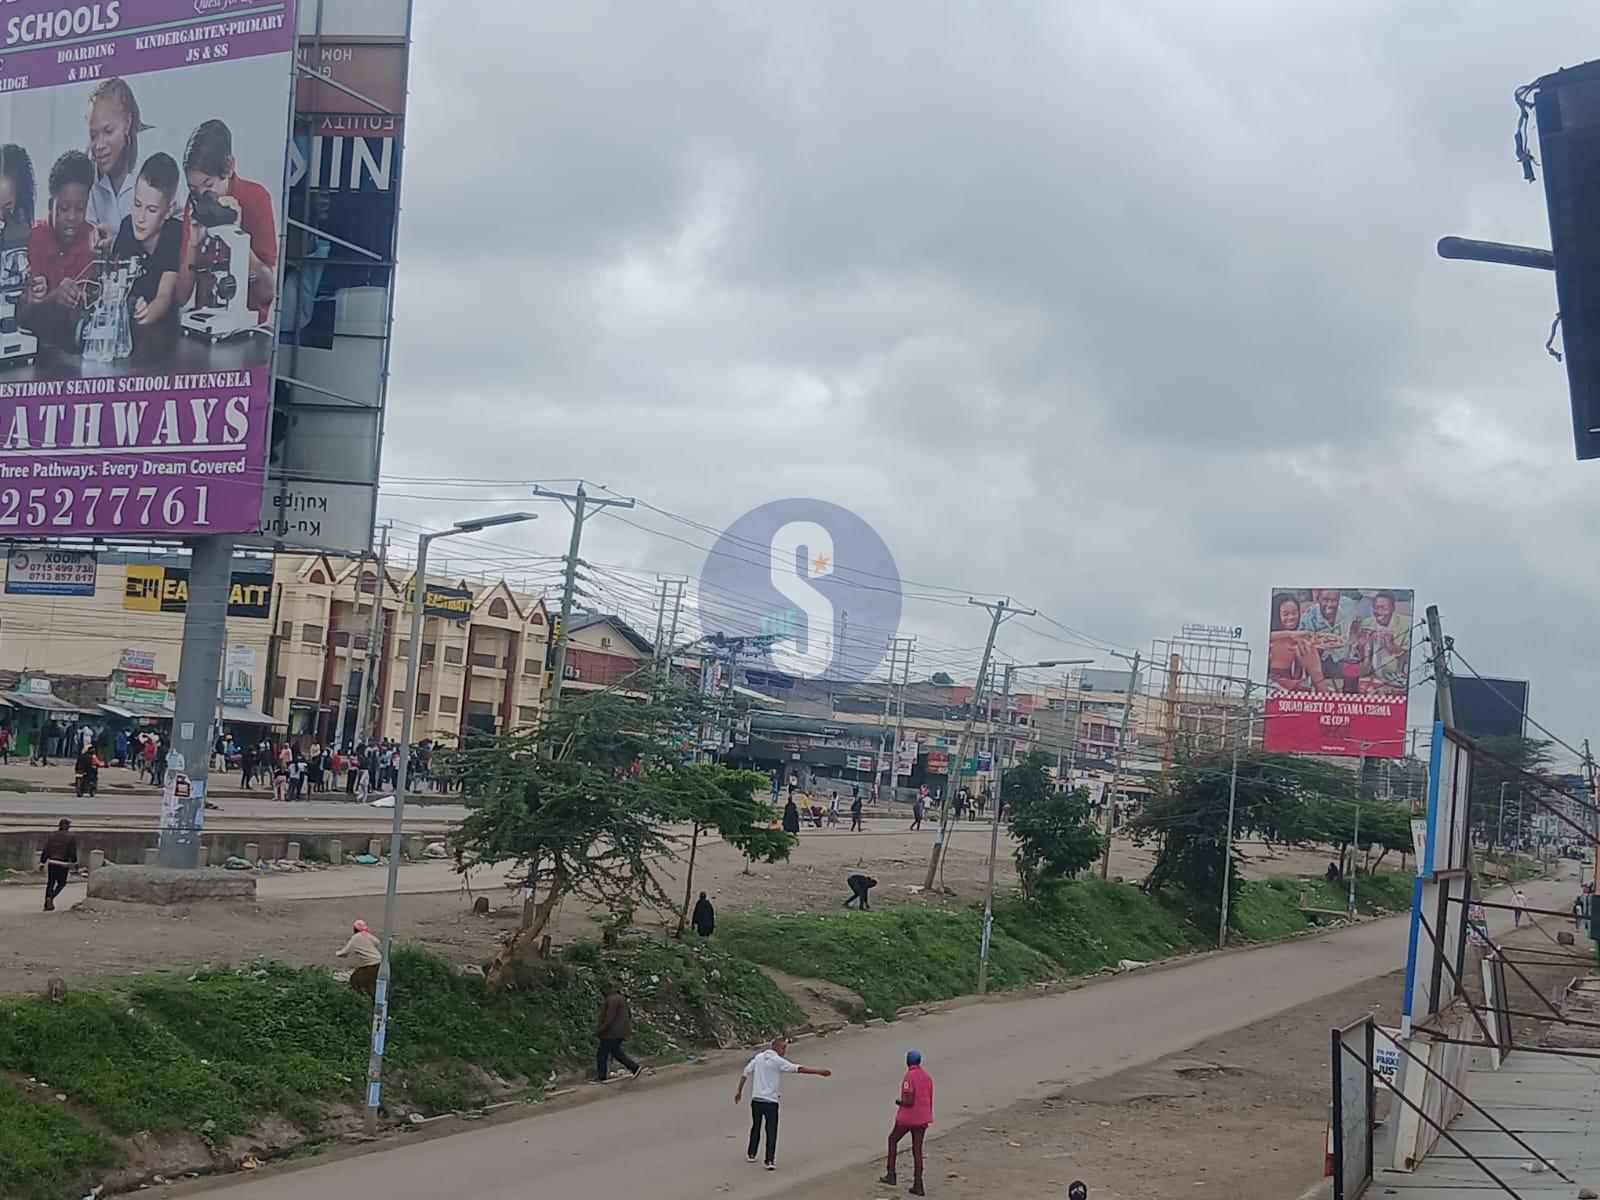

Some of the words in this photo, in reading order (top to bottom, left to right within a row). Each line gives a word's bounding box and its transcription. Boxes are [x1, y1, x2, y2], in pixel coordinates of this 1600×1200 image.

[6, 1, 120, 45] SCHOOLS
[135, 15, 285, 50] KINDERGARTEN-PRIMARY
[57, 43, 116, 63] BOARDING
[186, 48, 200, 62] JS
[202, 46, 211, 60] &
[213, 43, 229, 57] SS
[318, 48, 352, 61] HOM
[68, 68, 76, 80] &
[79, 64, 103, 80] DAY
[0, 75, 29, 91] IDGE
[66, 378, 115, 395] SENIOR
[118, 375, 171, 393] SCHOOL
[174, 370, 251, 390] KITENGELA
[2, 396, 250, 449] ATHWAYS
[32, 462, 98, 480] Pathways.
[102, 461, 139, 479] Every
[142, 460, 187, 475] Dream
[190, 456, 247, 474] Covered
[0, 486, 210, 526] 25277761
[273, 492, 328, 512] kulipa
[263, 519, 320, 536] Ku-fur
[29, 572, 52, 580] 0713
[54, 573, 72, 581] 857
[30, 564, 52, 572] 0715
